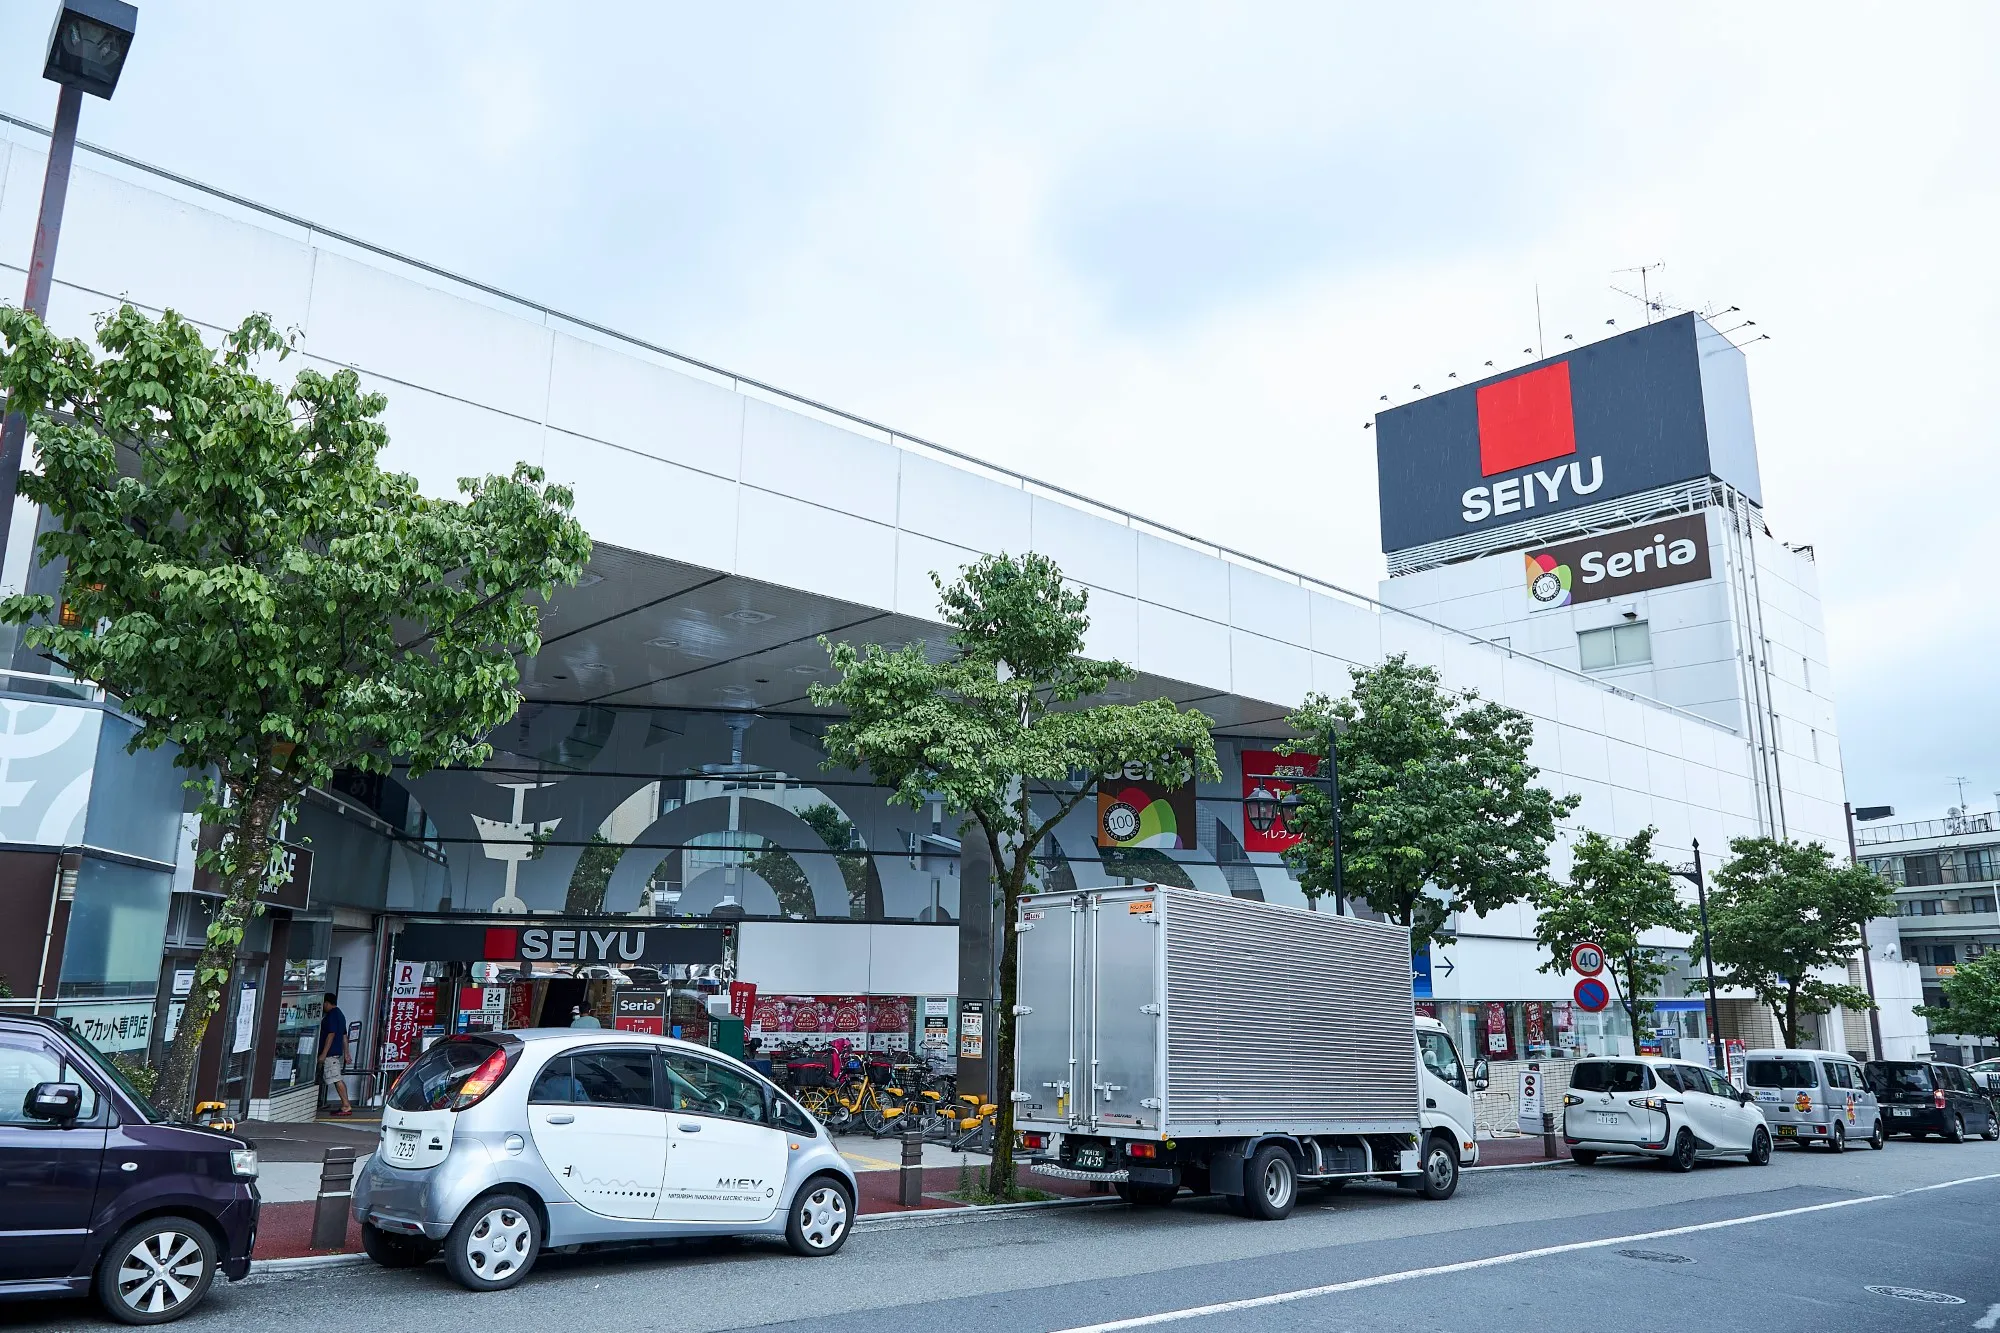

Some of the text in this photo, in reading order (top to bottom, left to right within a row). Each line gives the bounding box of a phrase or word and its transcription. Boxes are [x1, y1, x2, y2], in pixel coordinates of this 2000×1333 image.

[1462, 456, 1604, 523] SEIYU
[1580, 533, 1697, 585] Seria
[1537, 580, 1556, 595] 100
[1110, 814, 1134, 831] 100
[521, 929, 646, 961] SEIYU
[1579, 952, 1599, 968] 40
[401, 966, 412, 983] R
[487, 993, 501, 1003] 24
[620, 1000, 656, 1011] Seria
[396, 1142, 416, 1158] 72-39
[716, 1178, 763, 1190] MiEV
